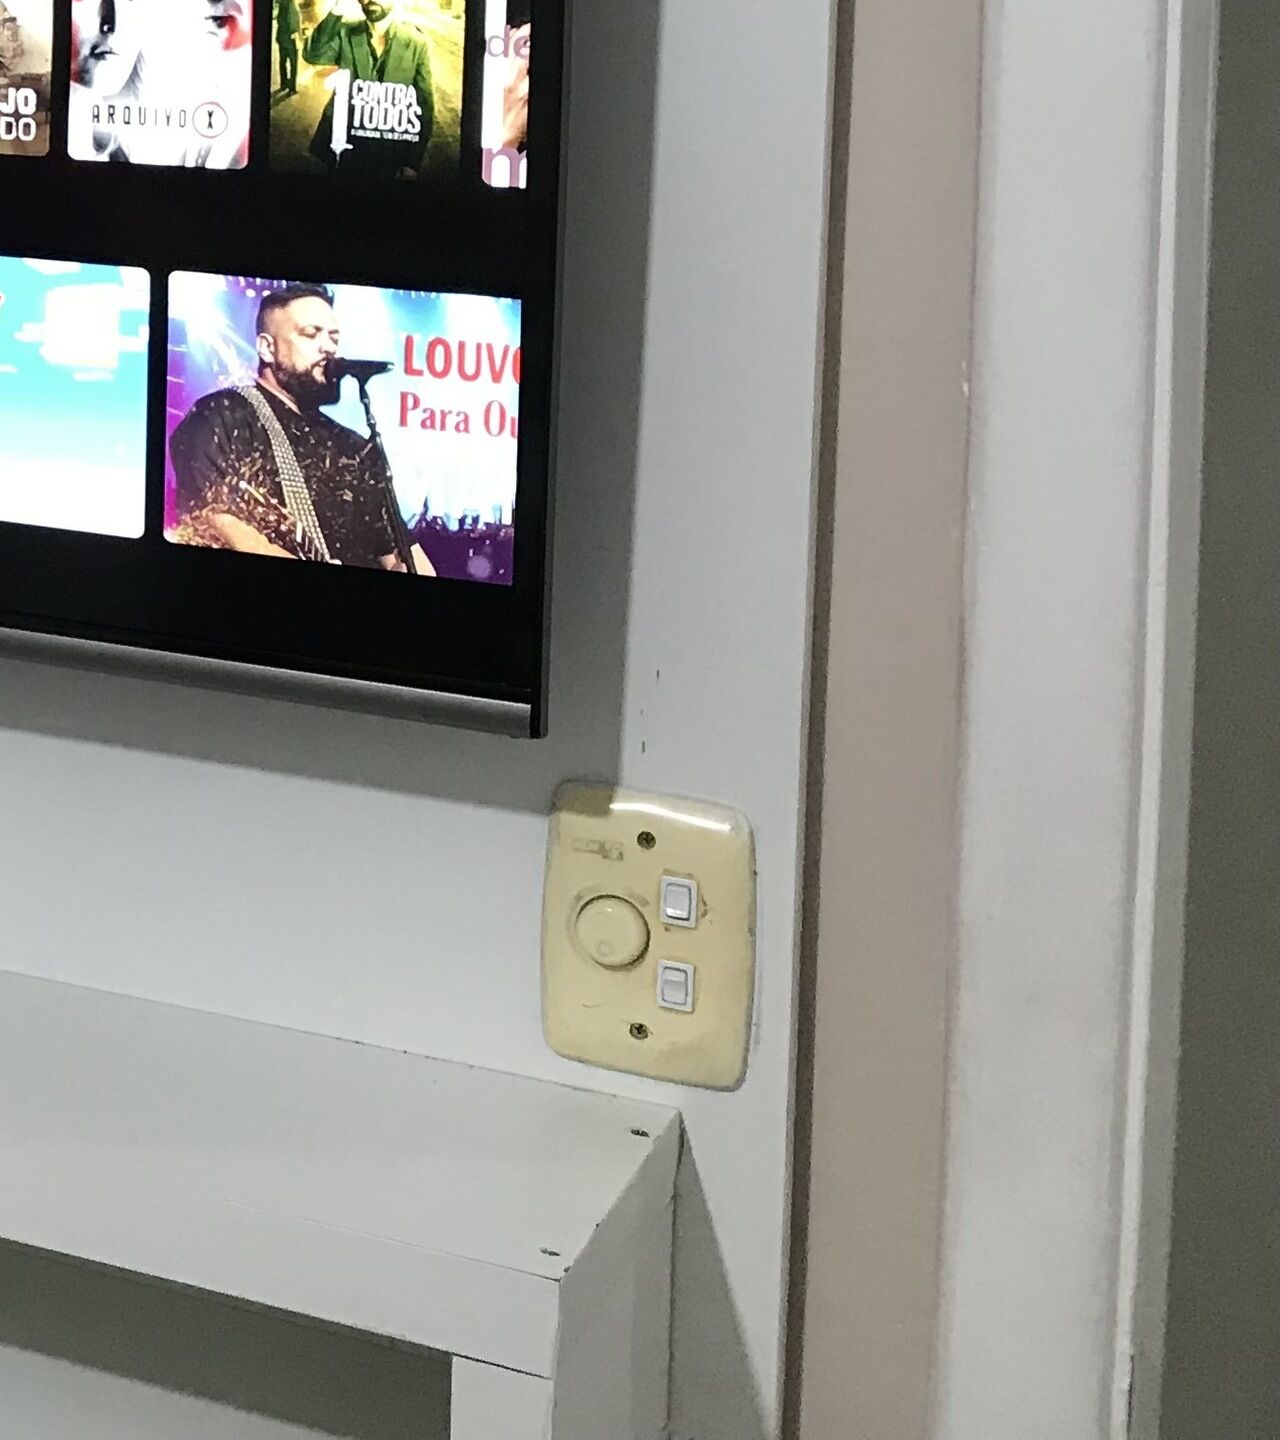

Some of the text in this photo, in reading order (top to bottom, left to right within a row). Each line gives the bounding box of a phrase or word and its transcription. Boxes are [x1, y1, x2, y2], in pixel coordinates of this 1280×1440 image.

[351, 79, 418, 106] CONTRA
[92, 103, 187, 128] ARQUIVO
[351, 99, 423, 134] TODOS
[399, 391, 471, 434] Para
